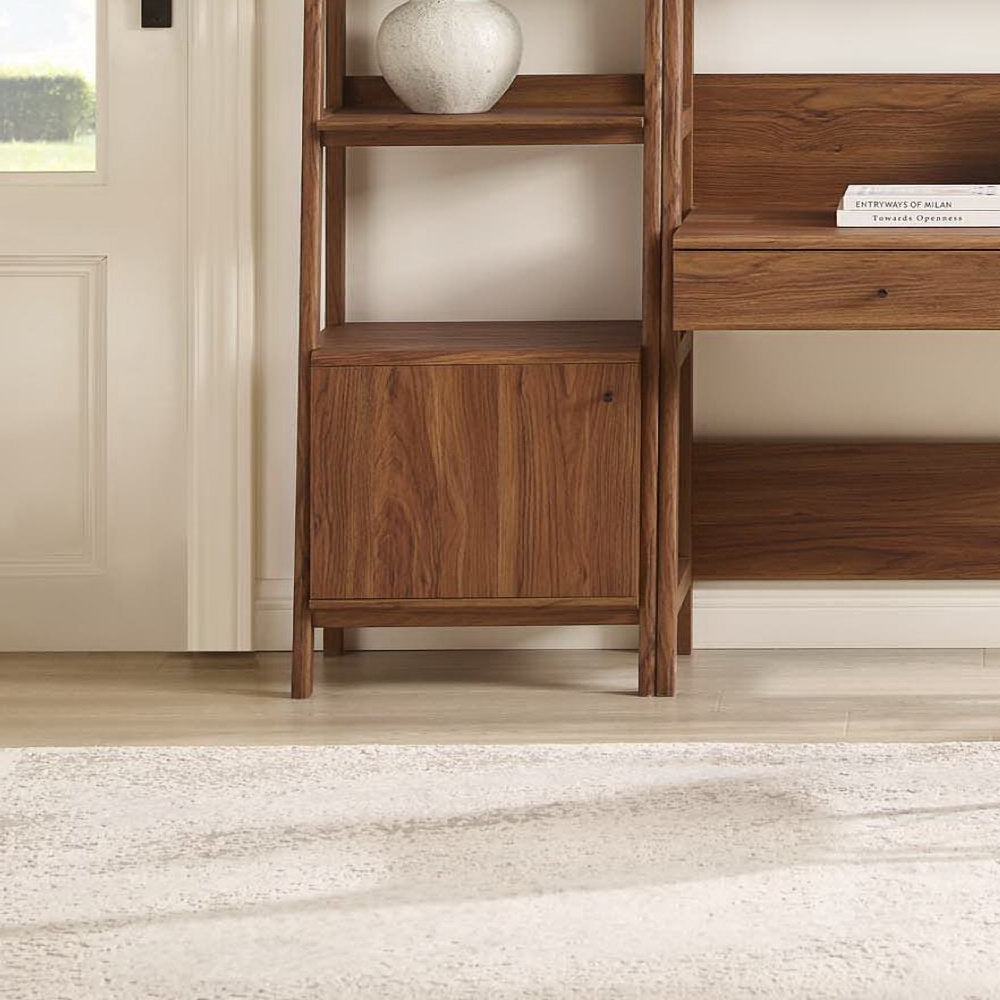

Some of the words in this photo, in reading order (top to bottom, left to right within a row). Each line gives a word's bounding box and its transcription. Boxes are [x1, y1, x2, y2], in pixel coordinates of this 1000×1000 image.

[855, 200, 909, 209] ENTRYWAYS
[910, 200, 923, 209] OF
[924, 200, 952, 209] MILAN
[916, 215, 963, 223] Openness
